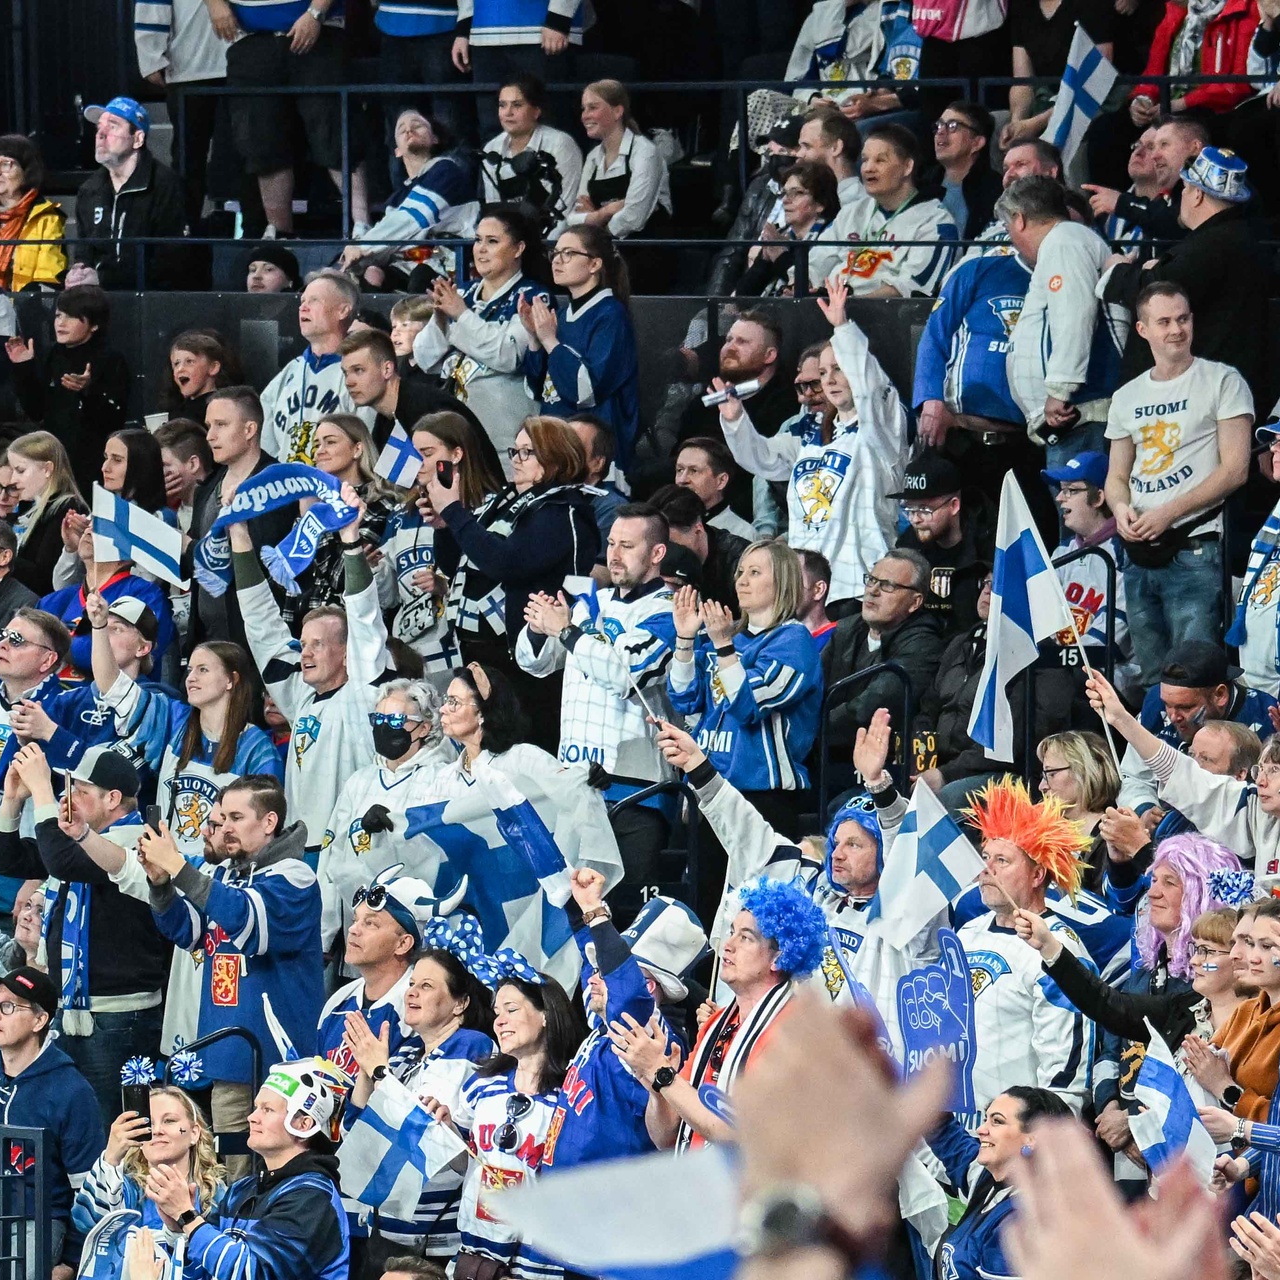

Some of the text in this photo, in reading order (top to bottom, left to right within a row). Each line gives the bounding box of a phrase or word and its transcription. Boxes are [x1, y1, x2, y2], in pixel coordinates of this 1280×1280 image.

[275, 386, 340, 428] SUOM
[1135, 399, 1188, 419] SUOMI
[795, 454, 845, 478] SUMI
[232, 475, 315, 514] apuan
[1059, 649, 1079, 666] 15
[698, 731, 732, 752] OMI
